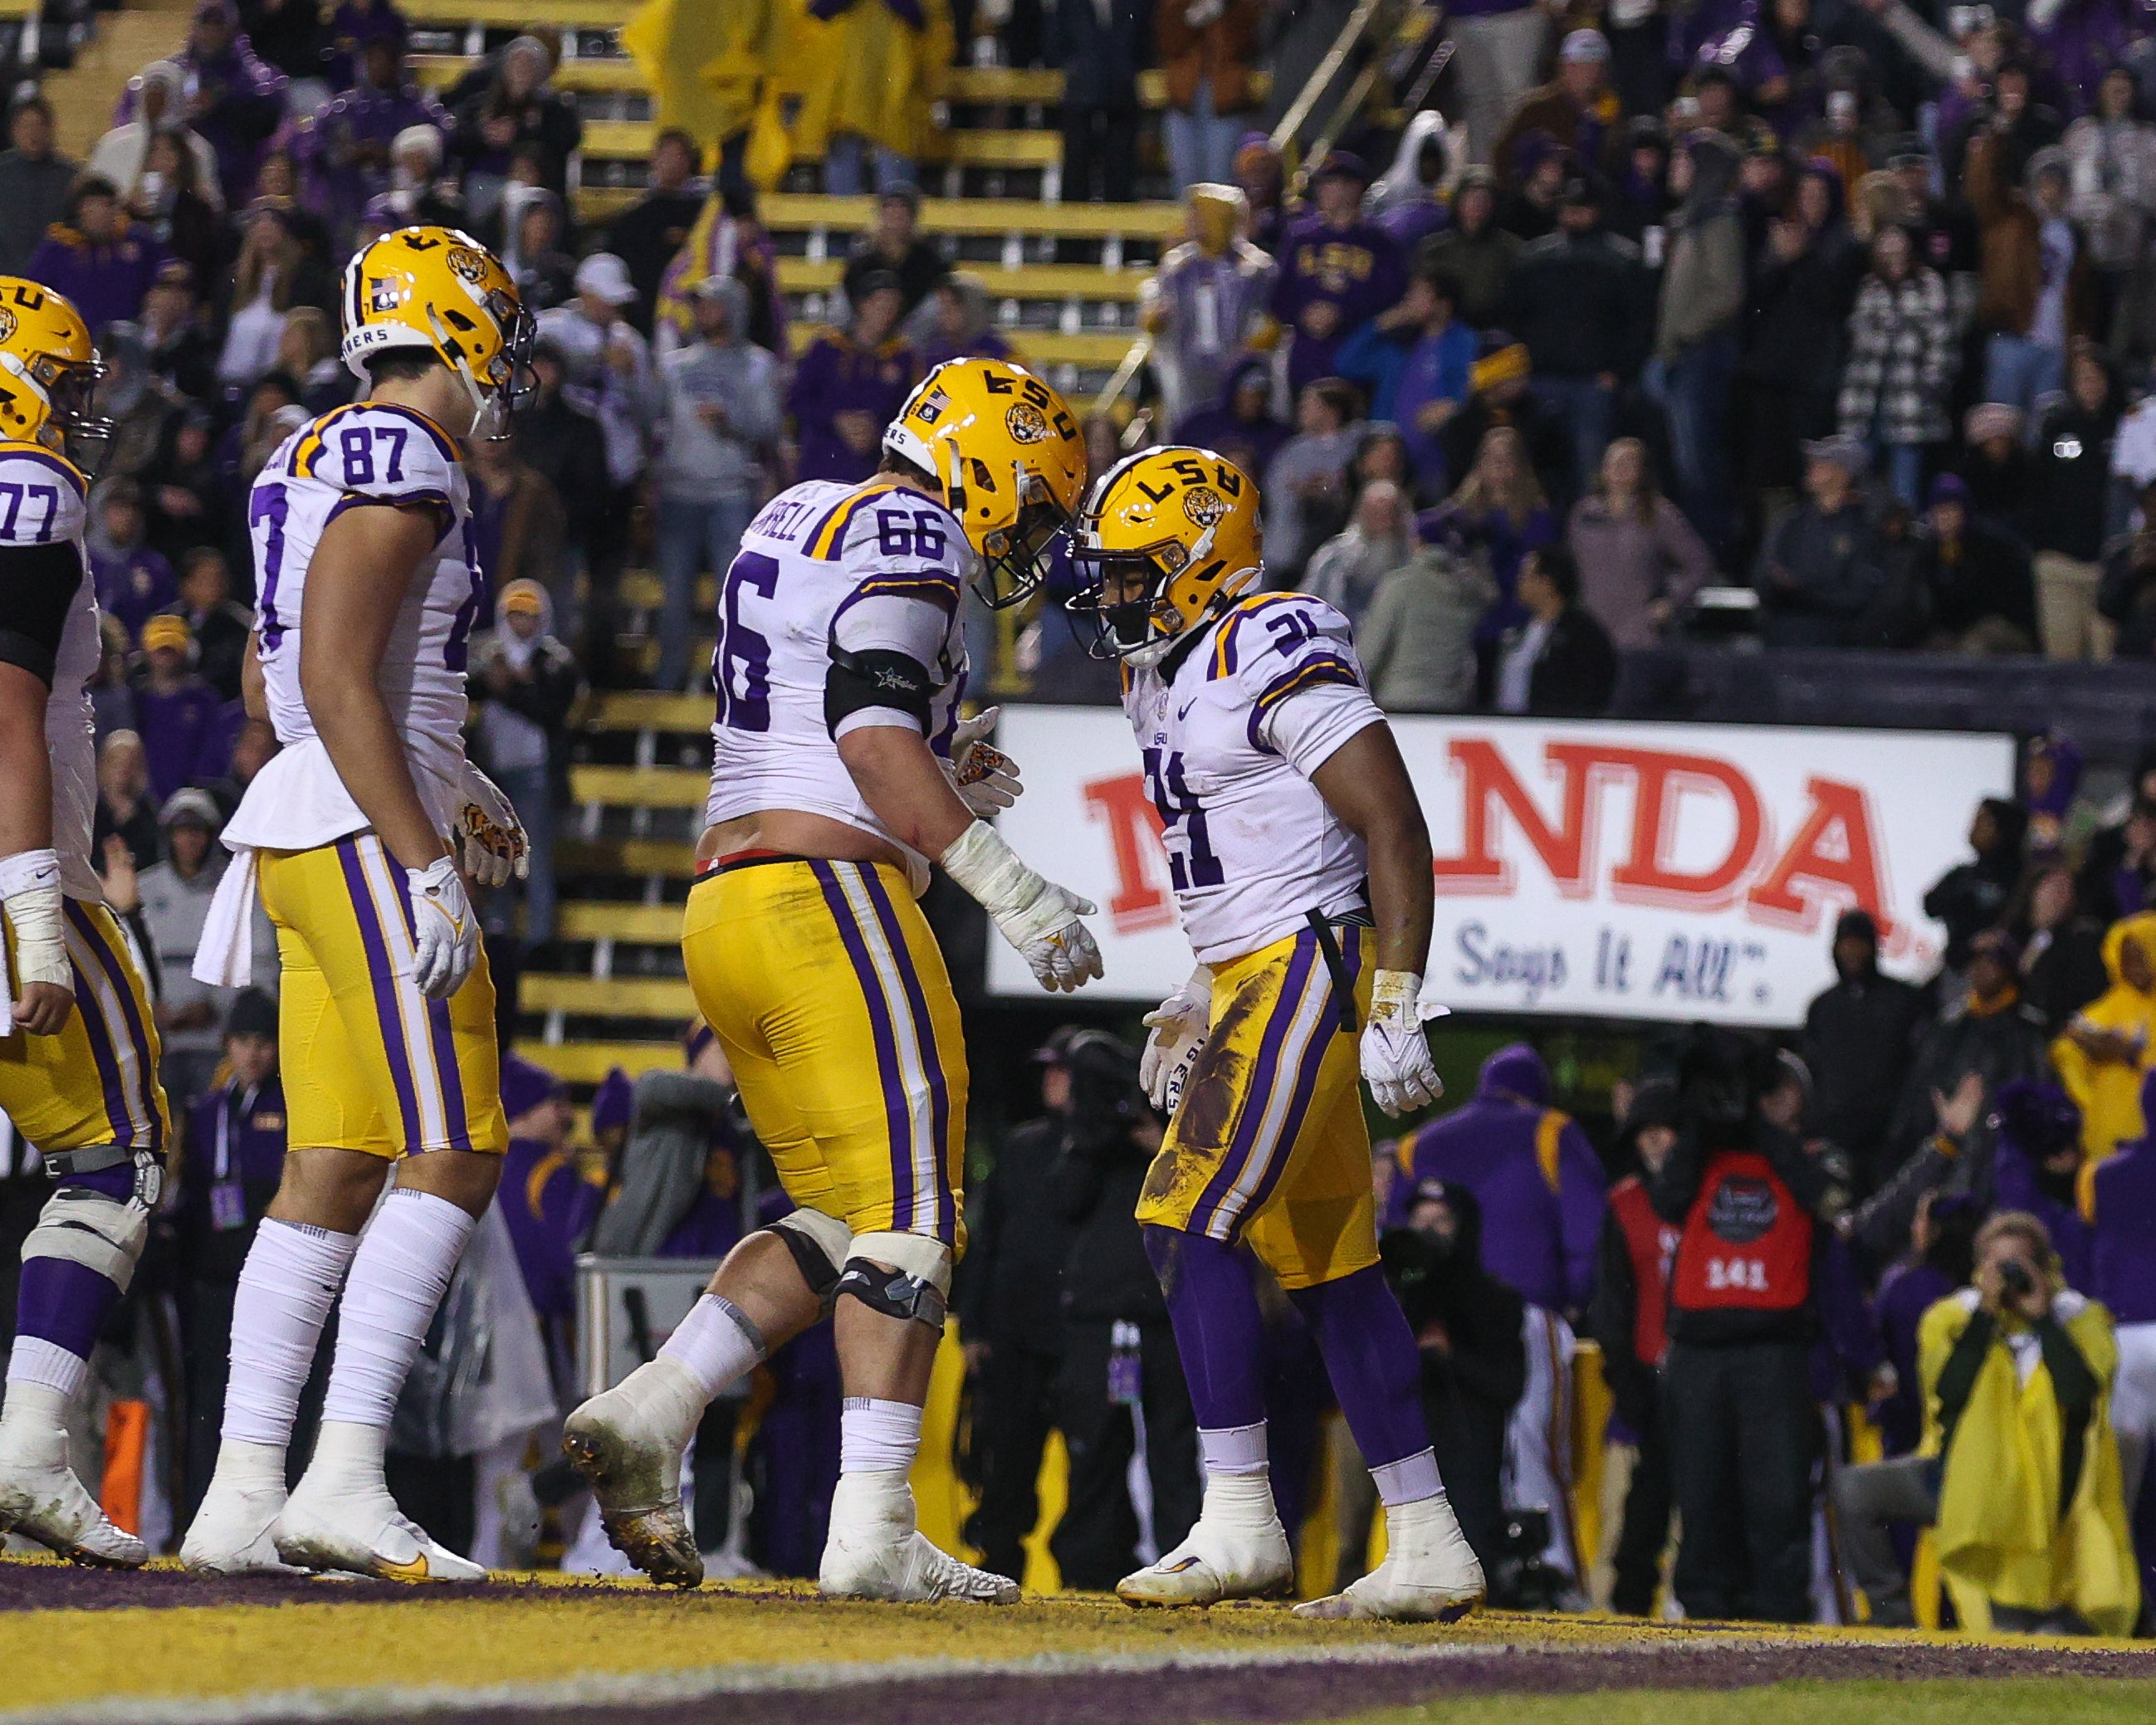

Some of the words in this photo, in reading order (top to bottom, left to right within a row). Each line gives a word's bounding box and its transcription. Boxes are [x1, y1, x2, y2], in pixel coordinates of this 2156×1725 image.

[983, 369, 1078, 442] LSU
[340, 427, 408, 486] 87
[1135, 458, 1240, 497] LSU
[0, 482, 58, 542] 77
[877, 509, 946, 560] 66
[1454, 920, 1567, 1003] Says
[1595, 923, 1634, 994] It
[1168, 1024, 1209, 1109] IGERS
